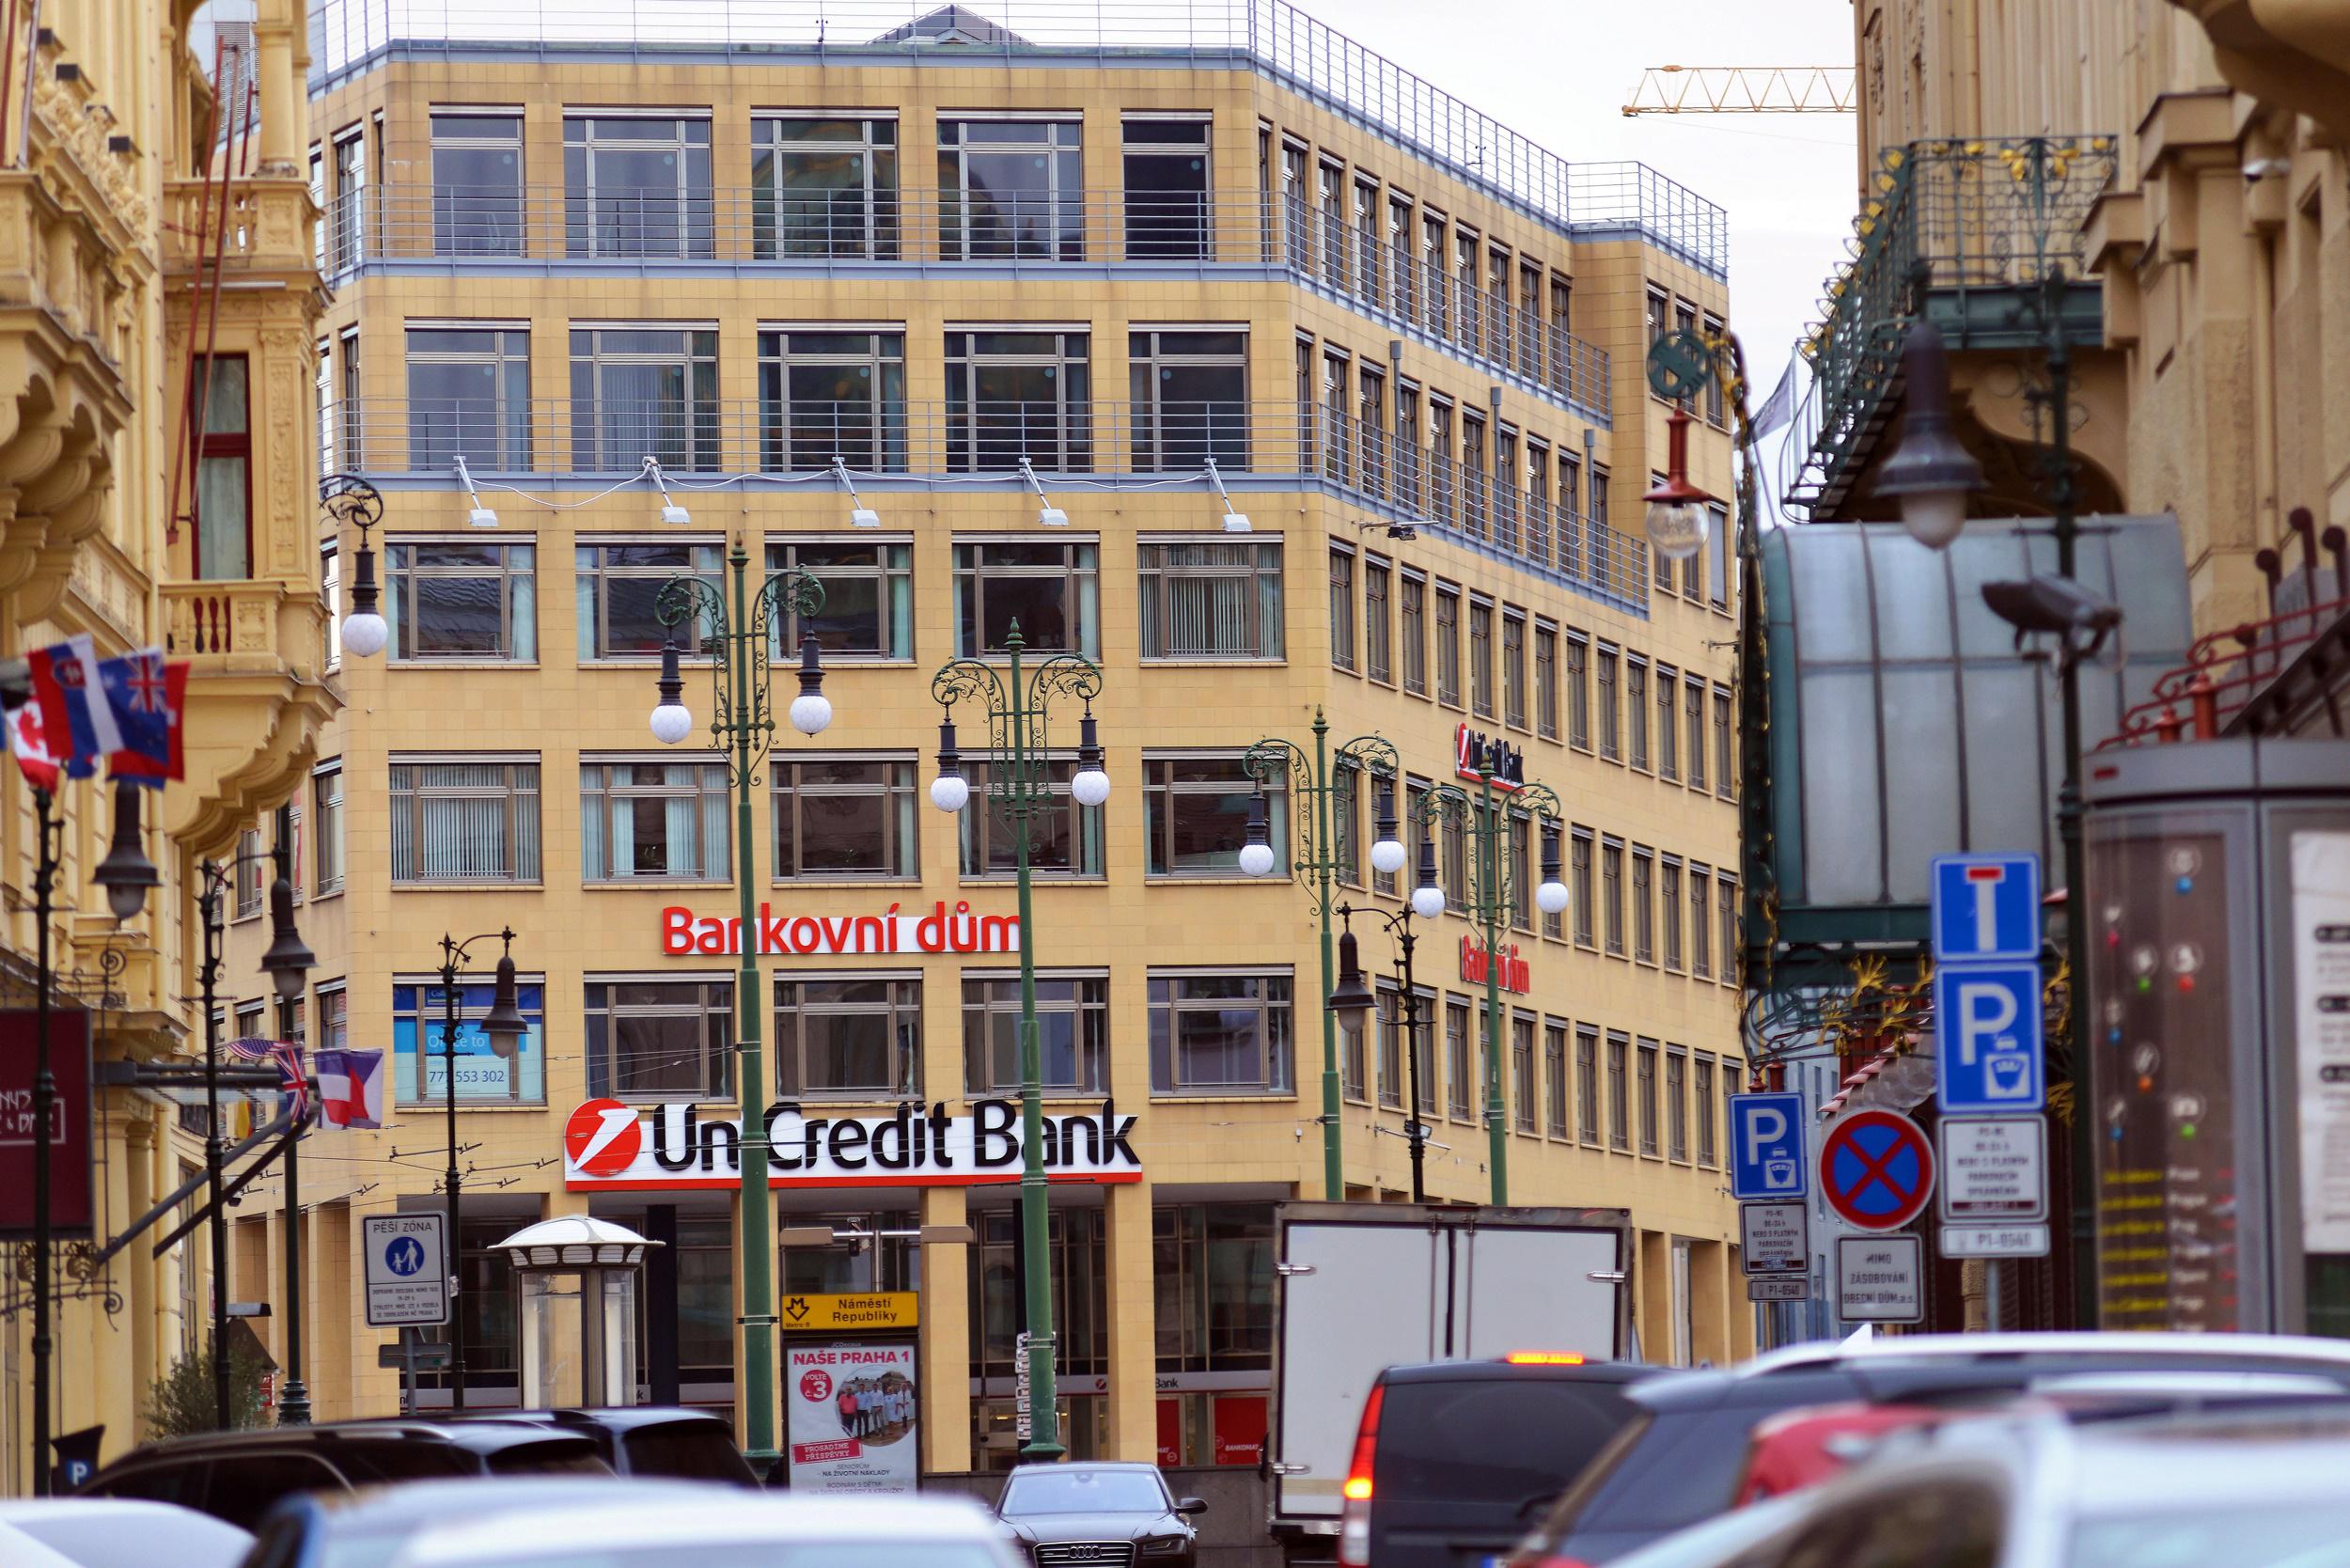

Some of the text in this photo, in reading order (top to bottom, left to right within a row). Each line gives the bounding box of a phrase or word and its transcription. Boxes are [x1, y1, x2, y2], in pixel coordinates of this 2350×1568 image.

[662, 902, 900, 955] Bankovní
[455, 1071, 478, 1082] 553
[482, 1071, 505, 1082] 302
[653, 1100, 953, 1171] UnCredit
[373, 1220, 432, 1233] PĚŠÍ ZÓNA
[1866, 1253, 1892, 1264] MIMO
[838, 1297, 891, 1309] Náměstí
[833, 1310, 898, 1324] Republiky
[793, 1350, 909, 1365] NAŠE PRAHA 1
[813, 1381, 827, 1399] 3
